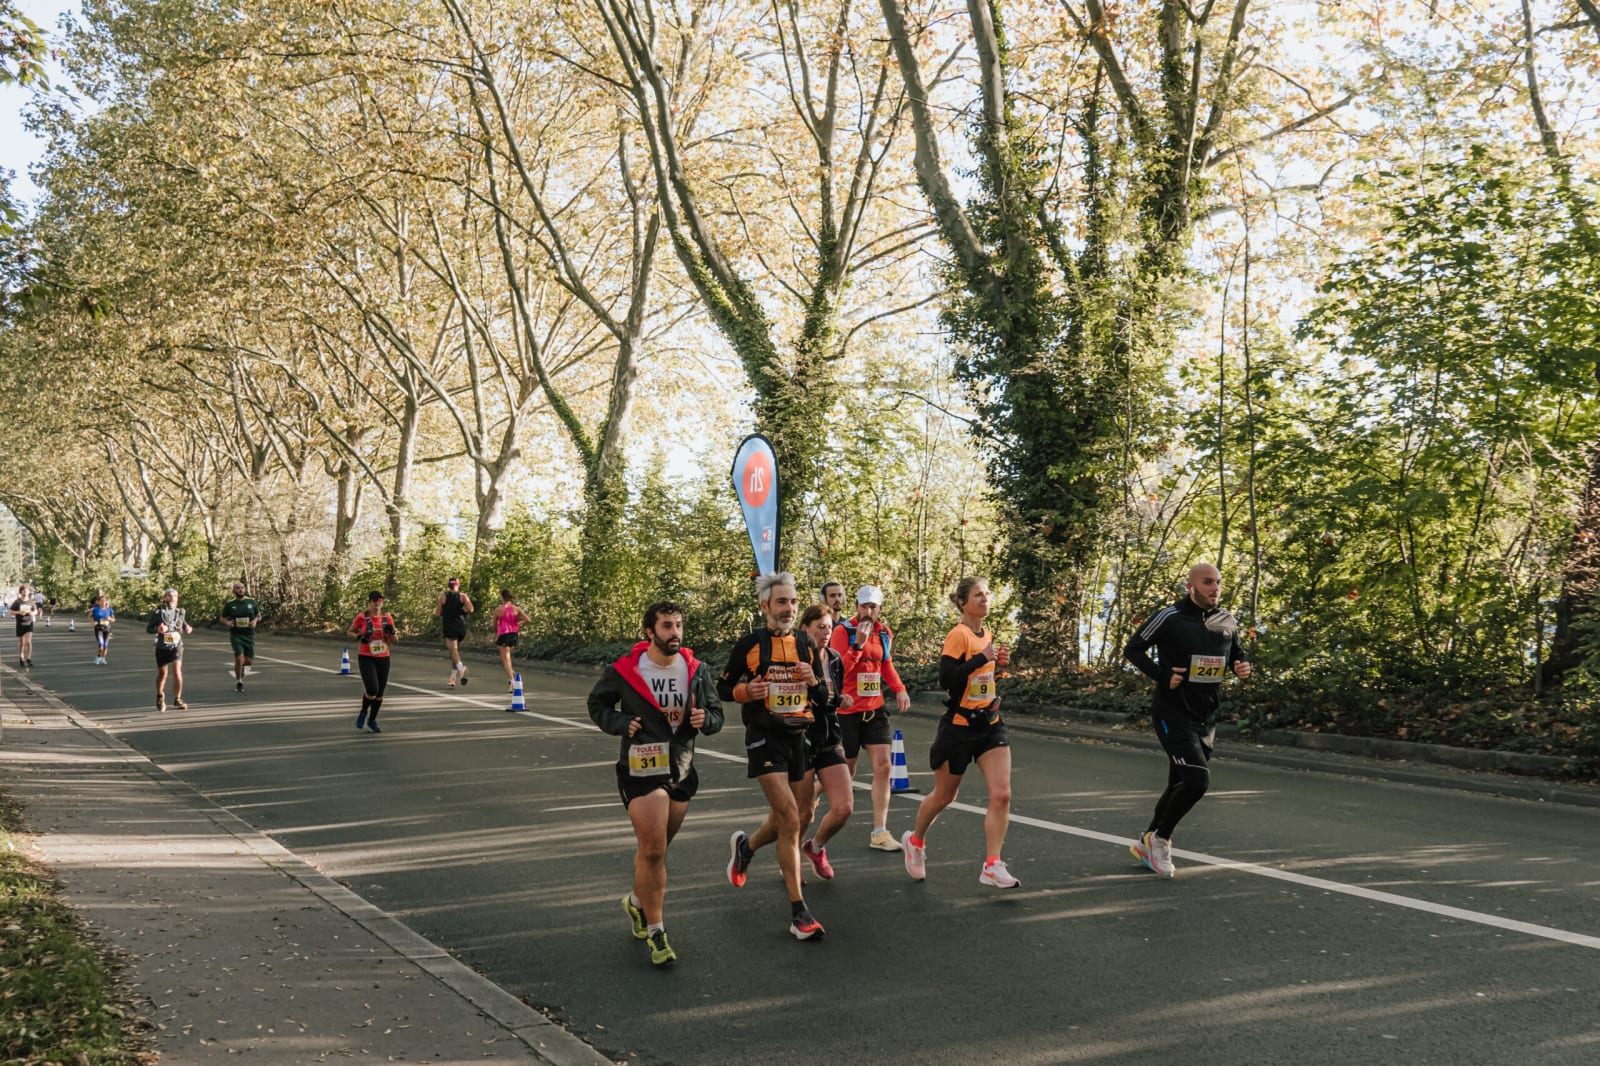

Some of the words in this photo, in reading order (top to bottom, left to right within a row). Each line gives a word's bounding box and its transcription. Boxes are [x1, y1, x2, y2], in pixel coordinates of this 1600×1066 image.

[1197, 666, 1220, 677] 247
[651, 678, 677, 692] WE
[980, 684, 987, 694] 9
[659, 693, 683, 707] UN
[776, 695, 801, 706] 310
[640, 756, 656, 769] 31
